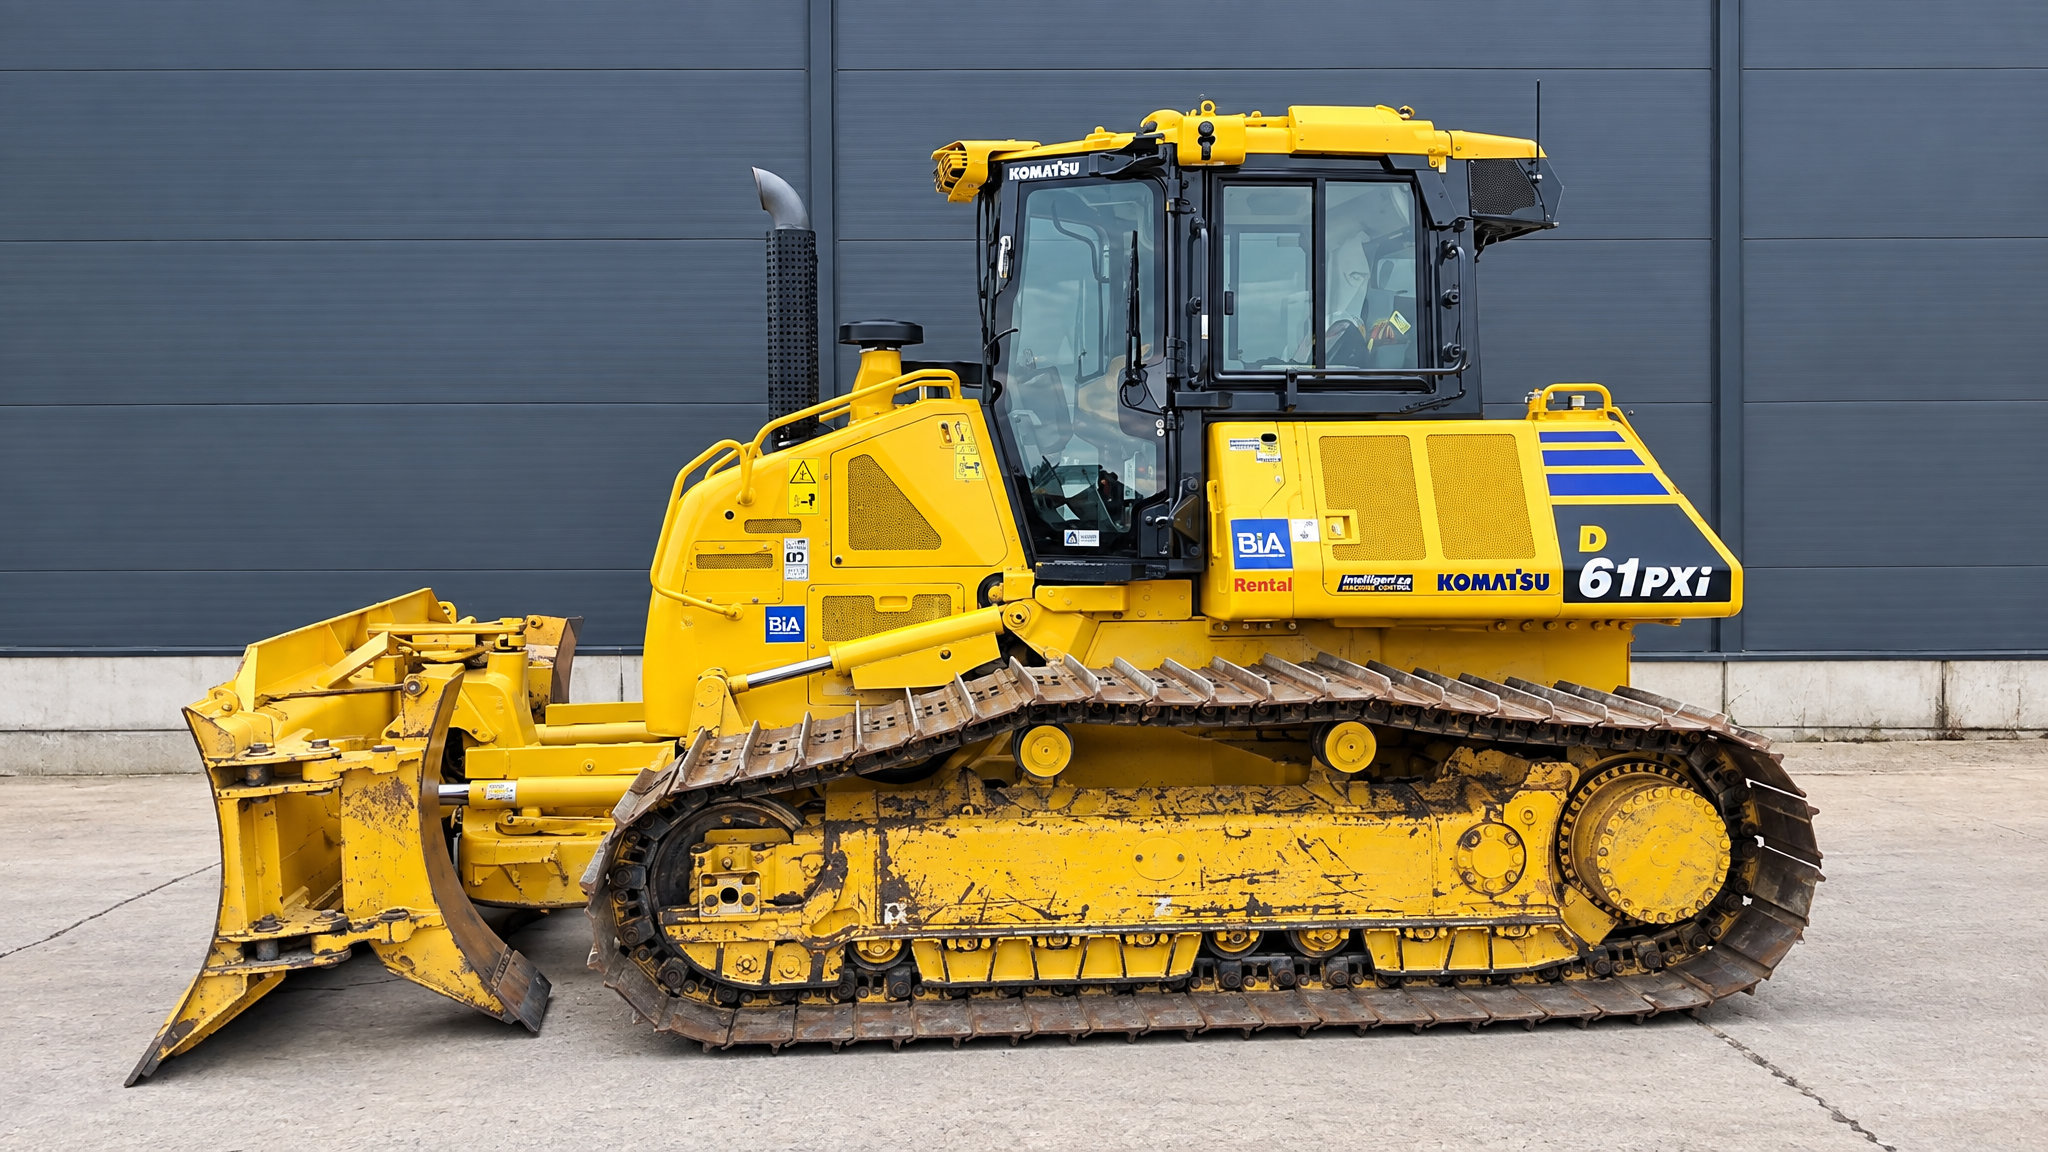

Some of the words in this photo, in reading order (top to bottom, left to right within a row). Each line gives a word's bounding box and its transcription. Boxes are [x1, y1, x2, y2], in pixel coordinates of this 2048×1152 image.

[1009, 160, 1080, 181] KOMATSU
[1236, 532, 1286, 554] BiA
[1579, 525, 1608, 553] D
[1234, 577, 1293, 592] Rental
[1437, 569, 1550, 592] KOMATSU
[1579, 557, 1713, 599] 61PXi
[768, 616, 801, 632] BiA
